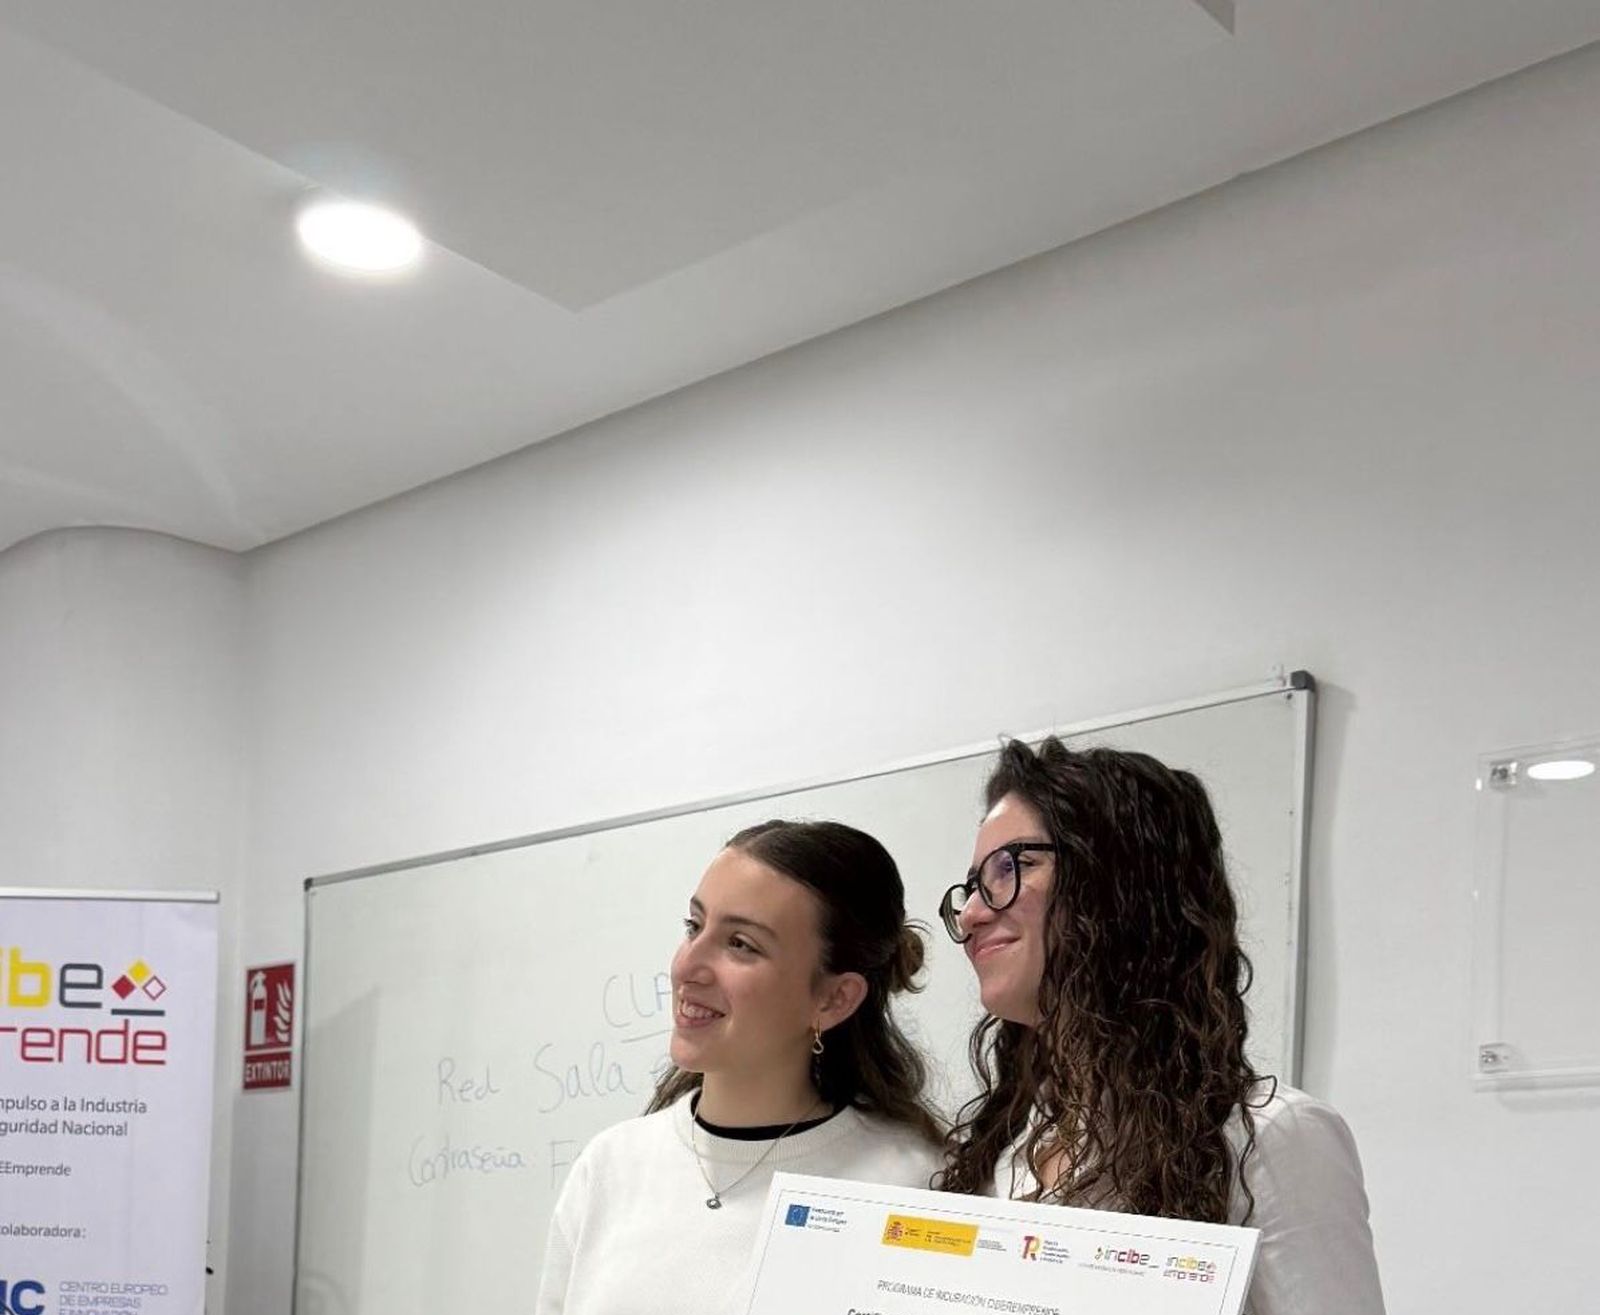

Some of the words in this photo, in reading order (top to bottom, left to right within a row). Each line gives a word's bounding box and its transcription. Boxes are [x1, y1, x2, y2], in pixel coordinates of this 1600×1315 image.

[0, 945, 104, 1009] be
[246, 1060, 289, 1082] EXTINTOR
[438, 1057, 501, 1106] Red
[534, 1042, 636, 1114] Sala
[51, 1100, 60, 1111] a
[63, 1097, 77, 1111] la
[81, 1099, 148, 1114] Industria
[62, 1120, 129, 1136] Nacional
[59, 1281, 108, 1294] CENTRO
[110, 1284, 168, 1296] EUROPEO
[59, 1295, 76, 1306] DE
[78, 1296, 142, 1309] EMPRESAS
